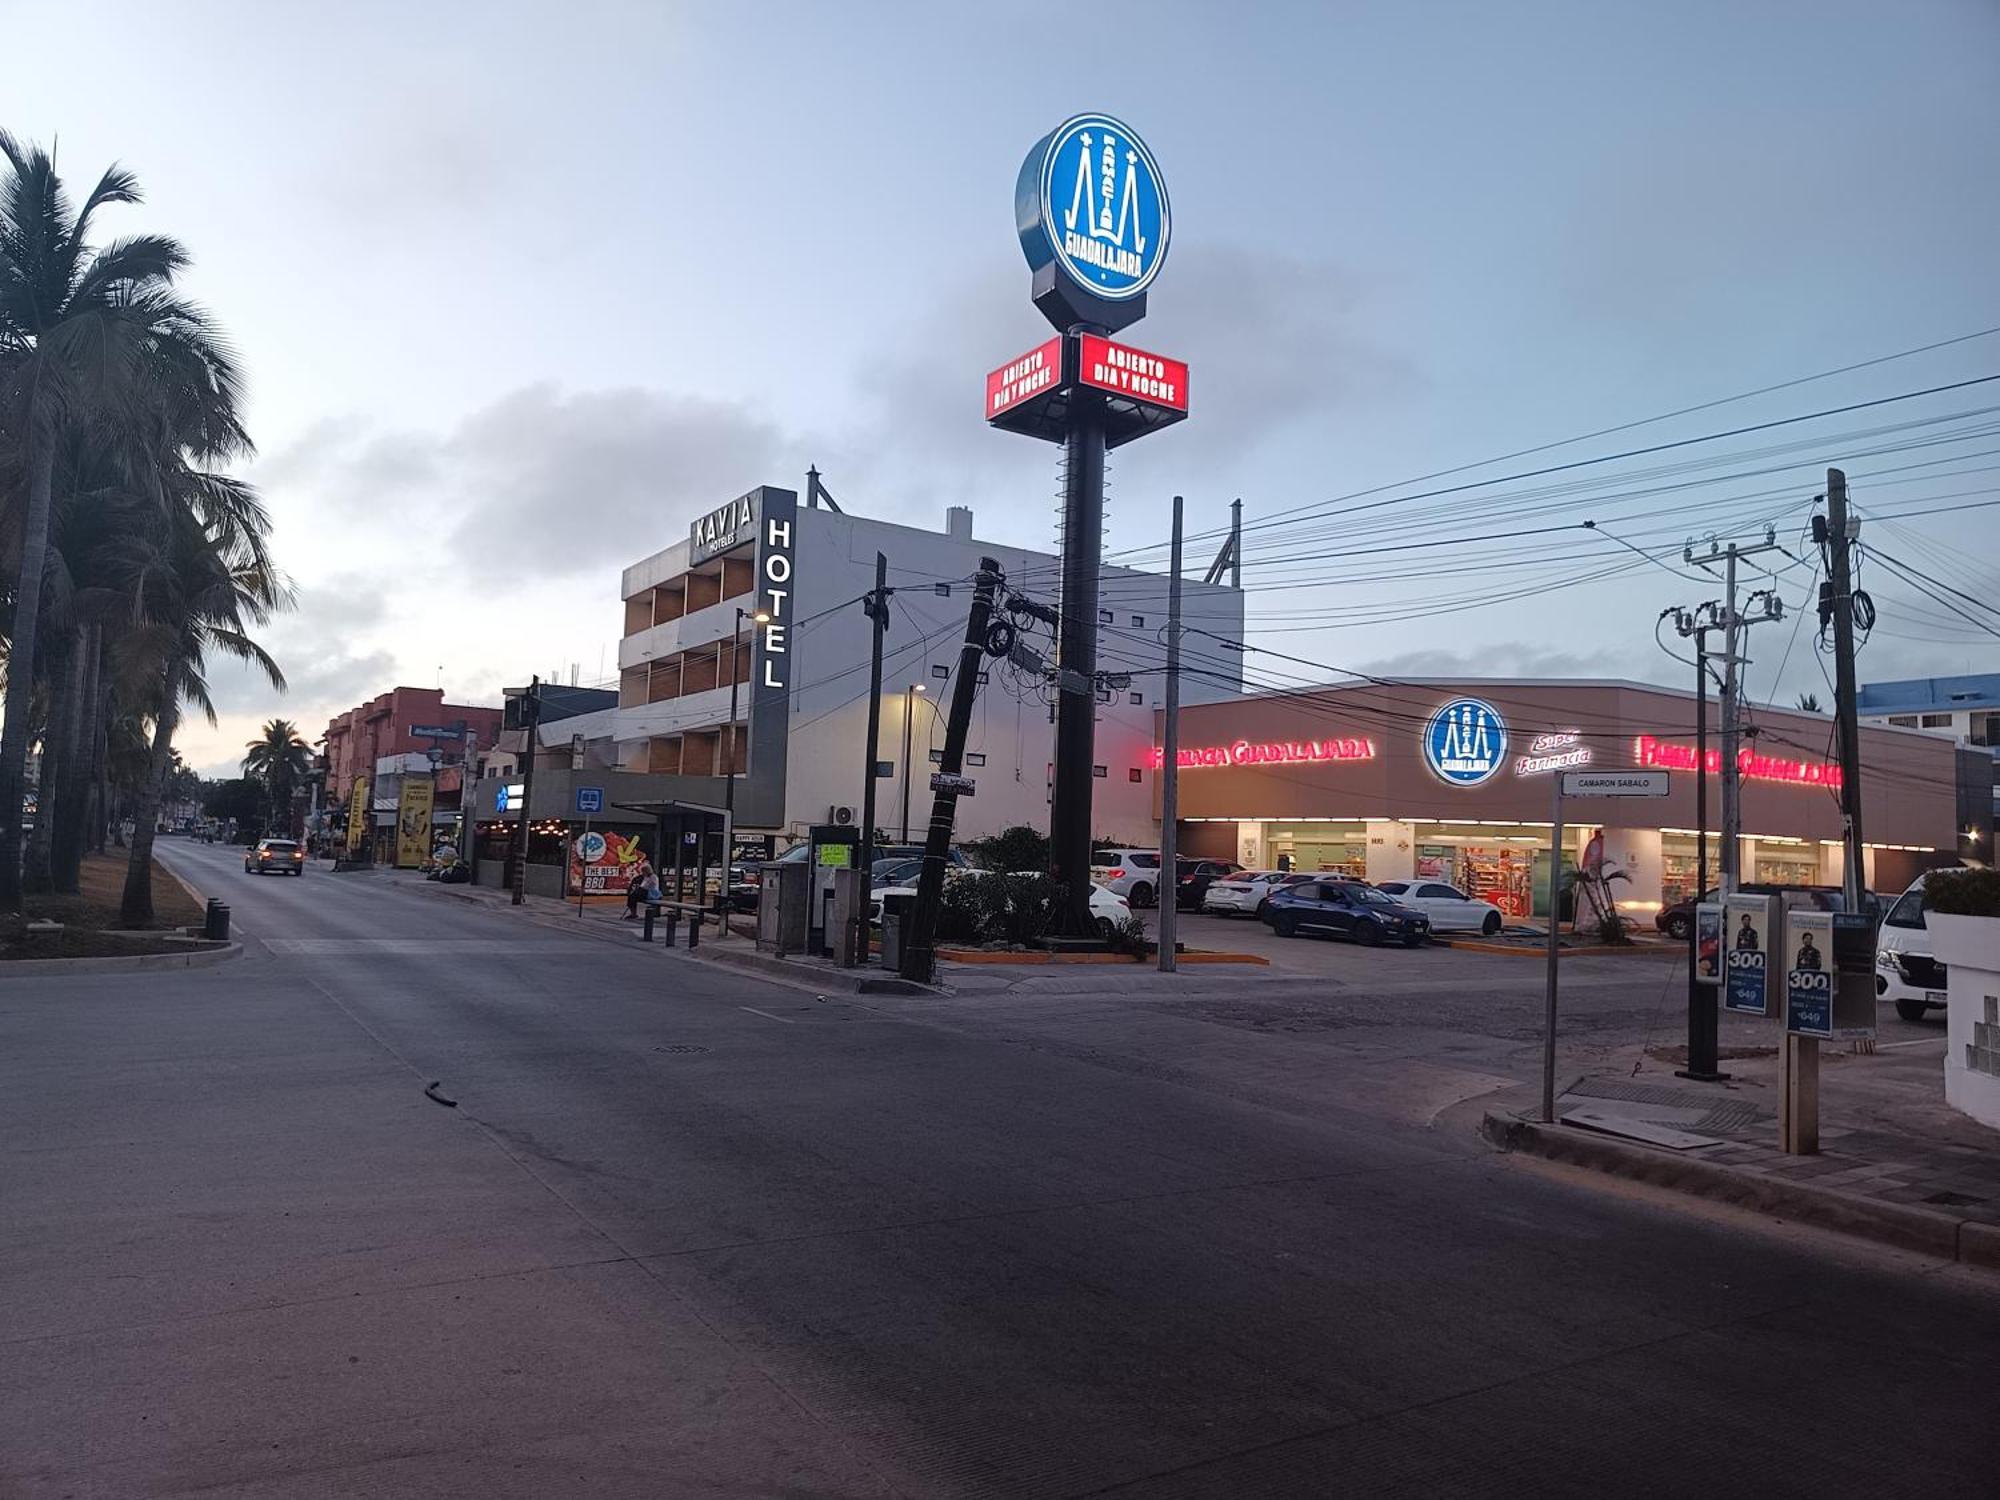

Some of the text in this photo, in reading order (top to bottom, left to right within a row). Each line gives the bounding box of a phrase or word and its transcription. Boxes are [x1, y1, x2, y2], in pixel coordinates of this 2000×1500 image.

[1100, 134, 1117, 230] FARMACIA
[1064, 230, 1142, 278] GUADALAJARA
[1002, 350, 1043, 385] ABIERTO
[1107, 347, 1165, 380] ABIERTO
[1011, 382, 1019, 400] Y
[1019, 367, 1051, 398] NOCHE
[1120, 372, 1131, 389] Y
[1131, 374, 1175, 402] NOCHE
[696, 496, 753, 547] KAVIA
[709, 531, 736, 553] HOTELES
[764, 520, 790, 687] HOTEL
[1230, 739, 1375, 765] GUADALAJARA
[1516, 748, 1591, 776] Farmacia
[1578, 778, 1650, 789] CAMARON SABALO
[584, 877, 606, 889] BBQ
[1728, 951, 1764, 969] 300
[1789, 972, 1828, 990] 300
